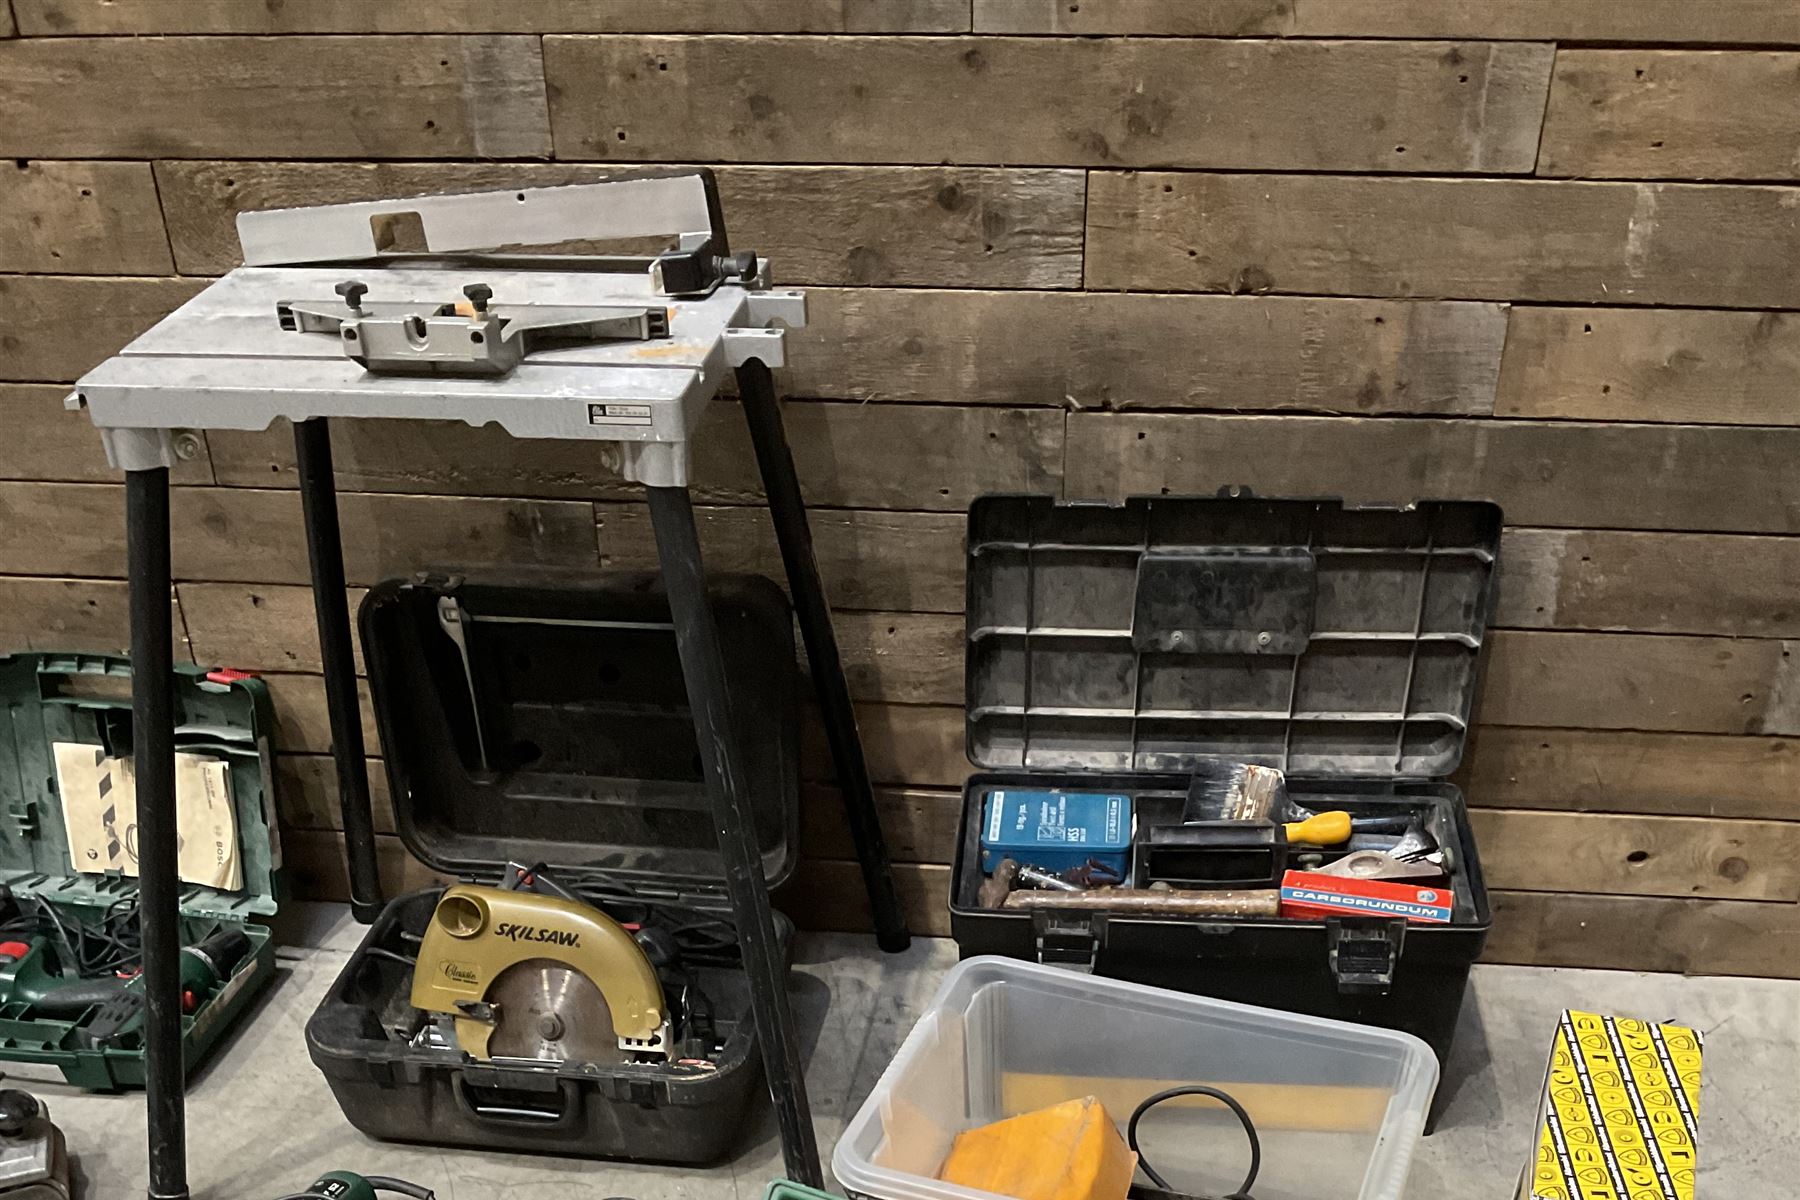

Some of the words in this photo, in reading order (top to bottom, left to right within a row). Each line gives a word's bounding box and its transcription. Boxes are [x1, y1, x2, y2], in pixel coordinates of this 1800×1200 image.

[216, 841, 224, 868] BOSC
[1292, 890, 1438, 917] CARBORUNDUM
[494, 923, 580, 948] SKILSAW
